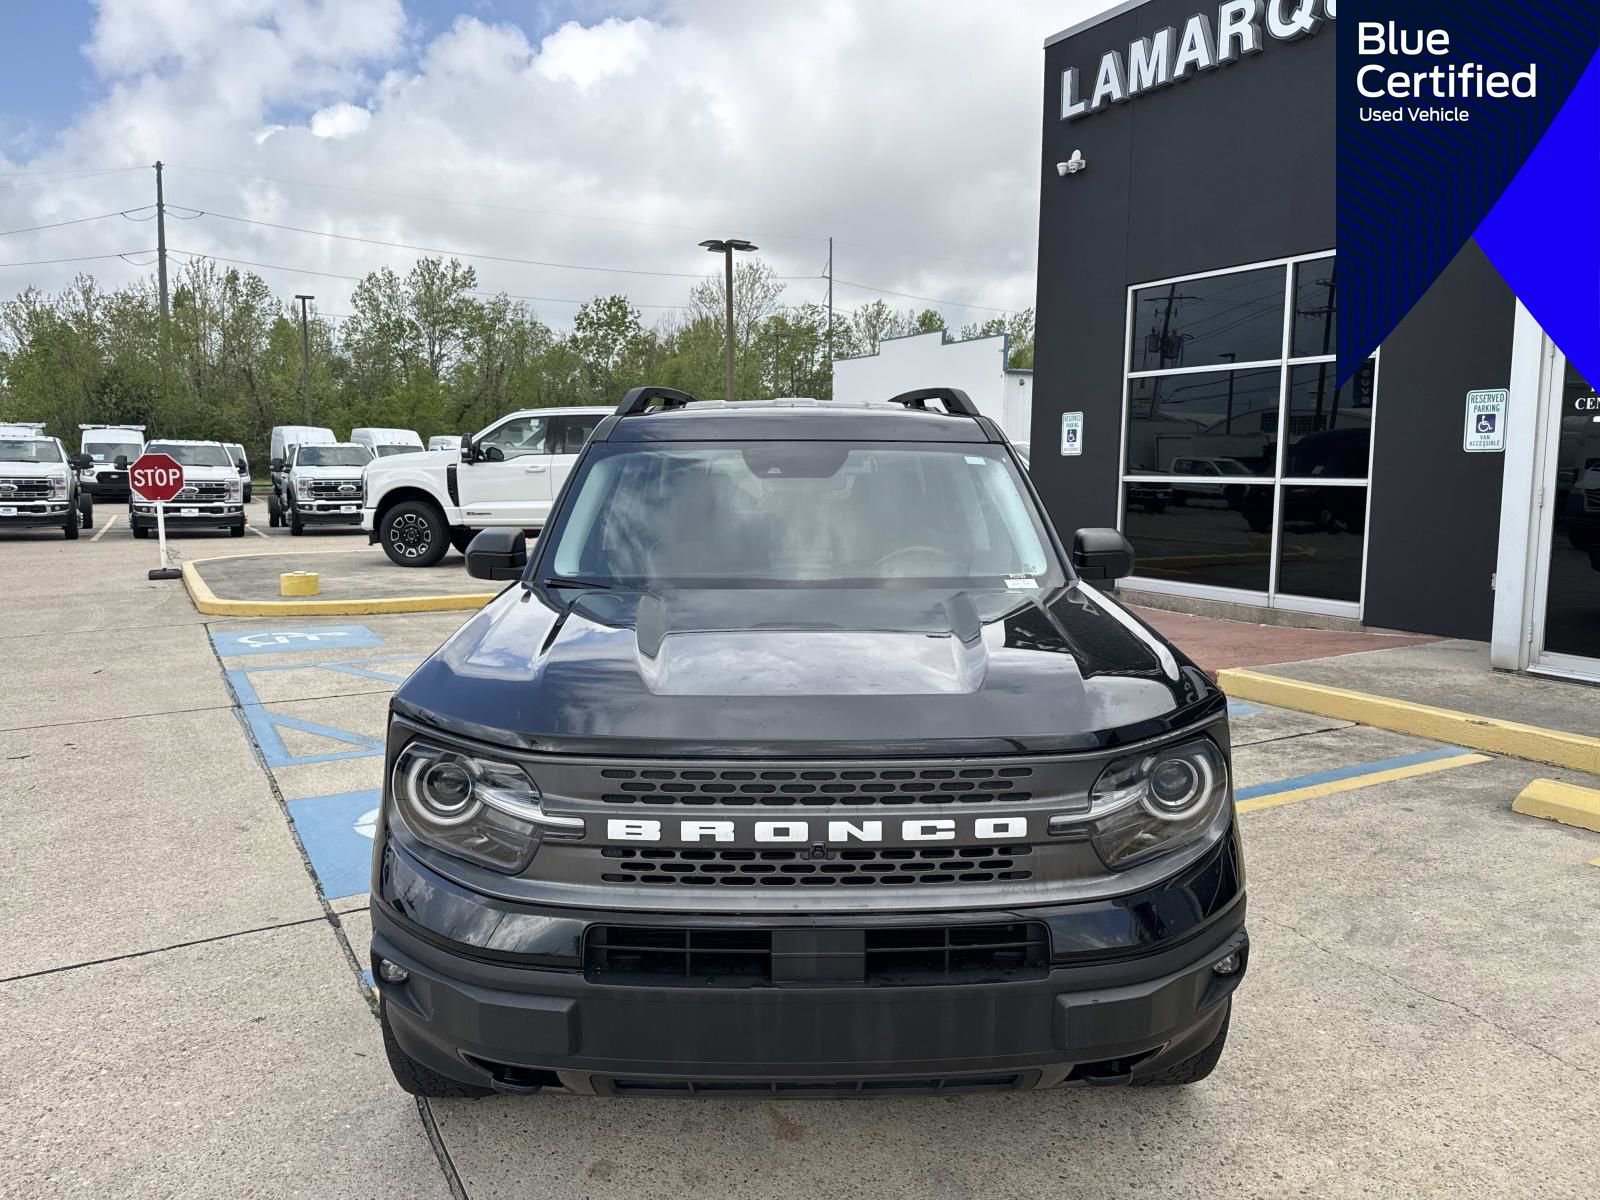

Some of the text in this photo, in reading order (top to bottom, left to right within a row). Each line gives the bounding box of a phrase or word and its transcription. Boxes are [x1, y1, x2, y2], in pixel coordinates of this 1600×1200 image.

[1060, 0, 1336, 121] LAMARQ
[1470, 393, 1505, 404] RESERVED
[1473, 404, 1500, 413] PARKING
[133, 468, 180, 487] STOP
[607, 817, 1028, 842] BRONCO
